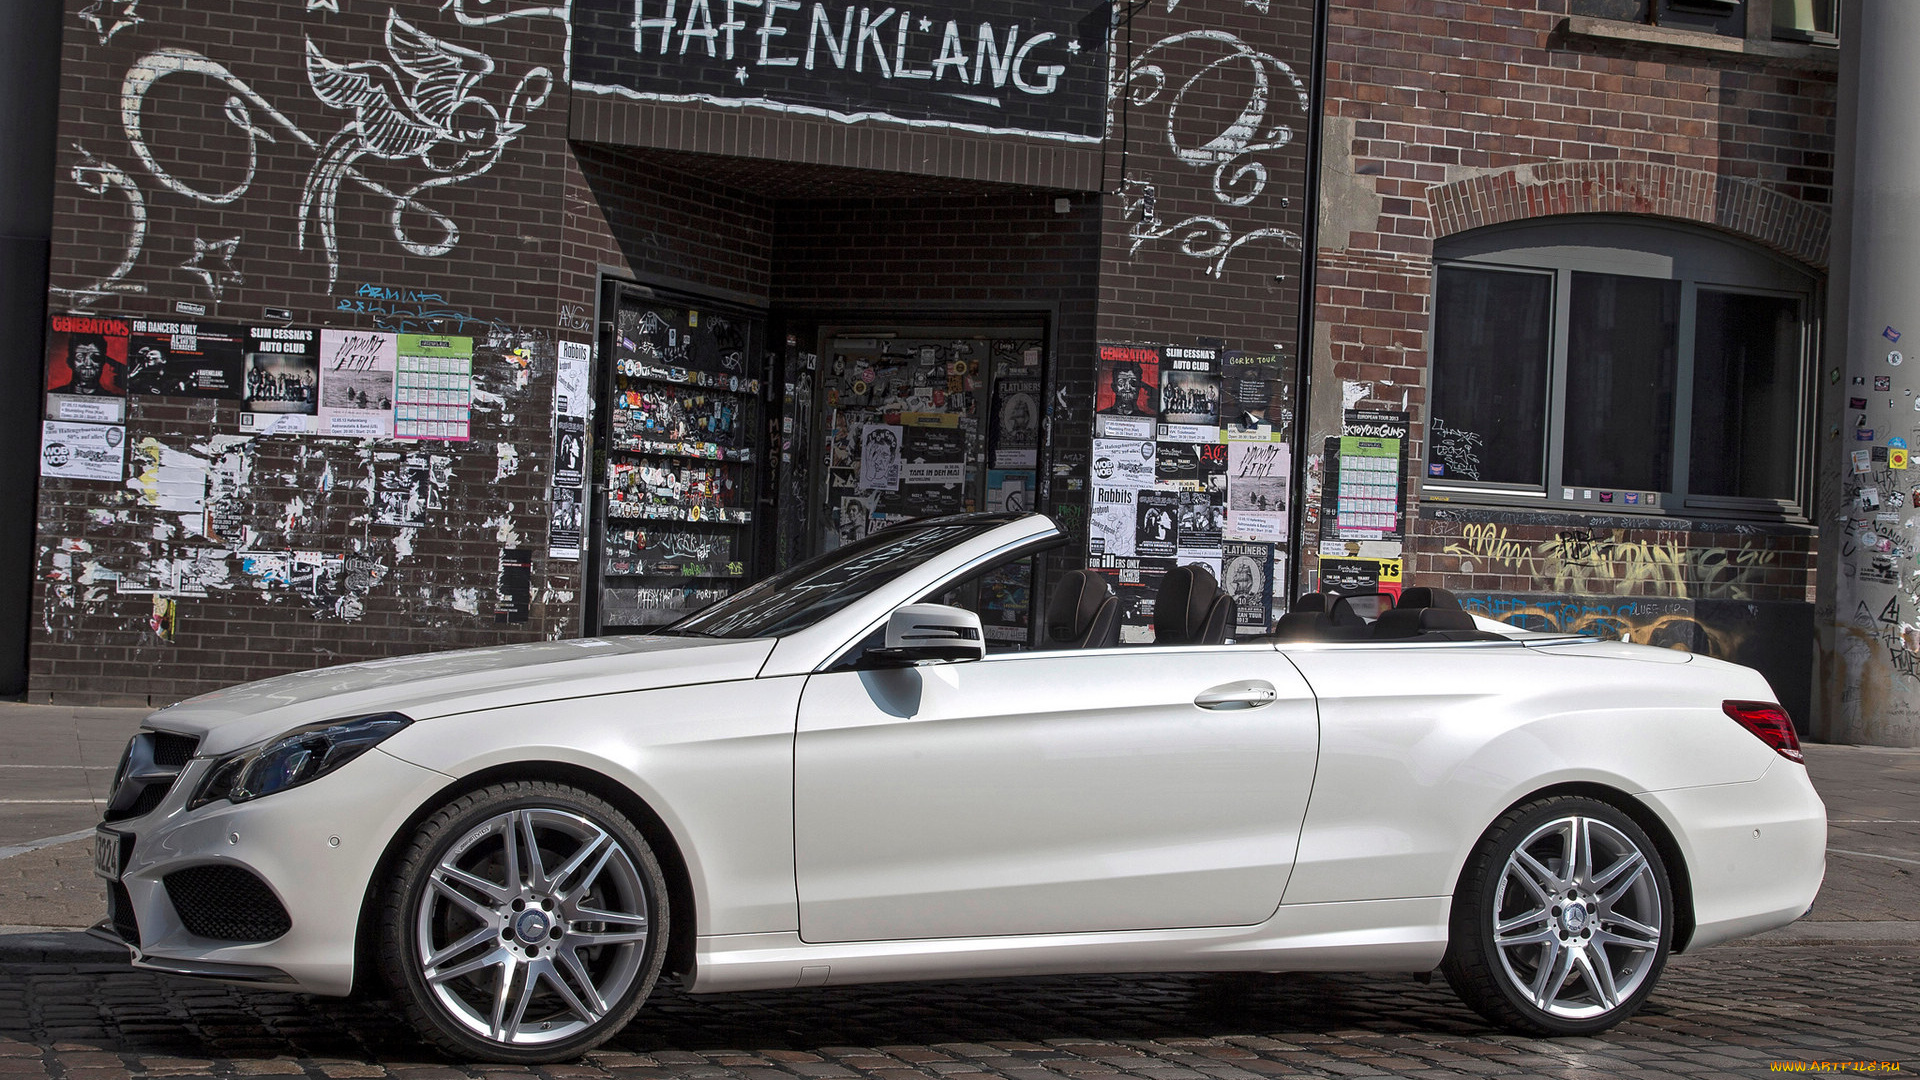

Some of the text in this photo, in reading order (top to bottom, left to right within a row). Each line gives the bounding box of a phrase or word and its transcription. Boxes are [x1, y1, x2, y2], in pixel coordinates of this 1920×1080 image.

[630, 0, 1066, 95] HAFENKLANG
[52, 317, 129, 335] GENERATORS
[133, 321, 197, 335] FOR DANCERS ONLY
[251, 327, 313, 341] SLIM CESSNA'S
[260, 341, 305, 353] AUTO CLUB
[563, 342, 587, 360] Rabbits
[1100, 346, 1159, 363] GENERATORS
[1166, 348, 1216, 360] SLIM CESSNA'S
[1256, 355, 1277, 364] TOUR
[1173, 360, 1210, 371] AUTO CLUB
[1001, 383, 1040, 392] FLATLINERS
[1098, 488, 1132, 504] Rabbits
[1223, 545, 1267, 555] FLATLINERS
[1089, 558, 1100, 567] FOR
[1127, 560, 1140, 568] ONLY
